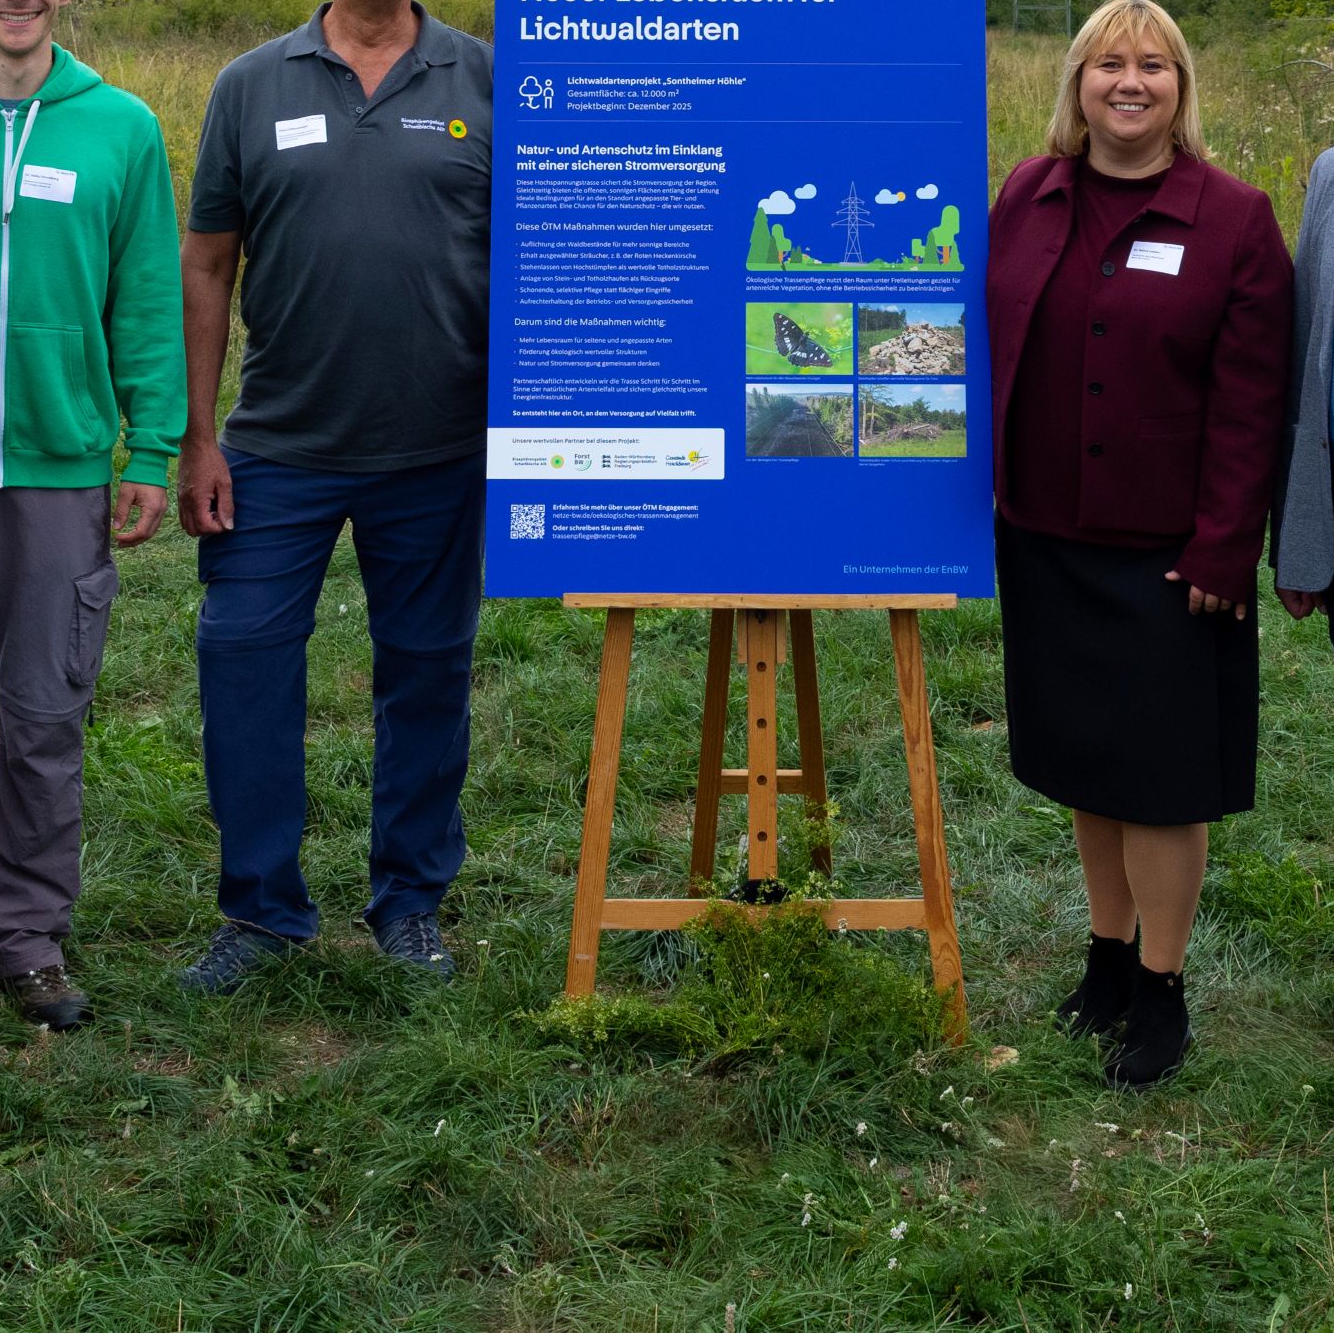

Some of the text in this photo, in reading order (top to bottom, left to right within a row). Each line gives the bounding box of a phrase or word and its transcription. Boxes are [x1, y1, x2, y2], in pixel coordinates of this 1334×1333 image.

[520, 15, 739, 41] Lichtwaldarten
[567, 77, 746, 86] Lichtwaldartenprojekt „Sontheimer Höhle“
[567, 89, 626, 98] Gesamtfläche:
[641, 90, 667, 98] 12.000
[567, 102, 692, 112] Projektbeginn: Dezember 2025
[517, 144, 723, 157] Natur- und Artenschutz im Einklang
[517, 159, 726, 173] mit einer sicheren Stromversorgung
[516, 222, 713, 233] Diese ÖTM Maßnahmen wurden hier umgesetzt:
[539, 252, 579, 260] ausgewählter
[906, 285, 955, 293] beeinträchtigen.
[514, 317, 666, 328] Darum sind die Maßnahmen wichtig:
[519, 348, 550, 356] Förderung
[642, 503, 658, 511] ÖTM
[658, 504, 698, 512] Engagement:
[553, 512, 699, 520] netze-bw.de/oekologisches-trassenmanagement
[843, 564, 969, 574] Ein Unternehmen der EnBW
